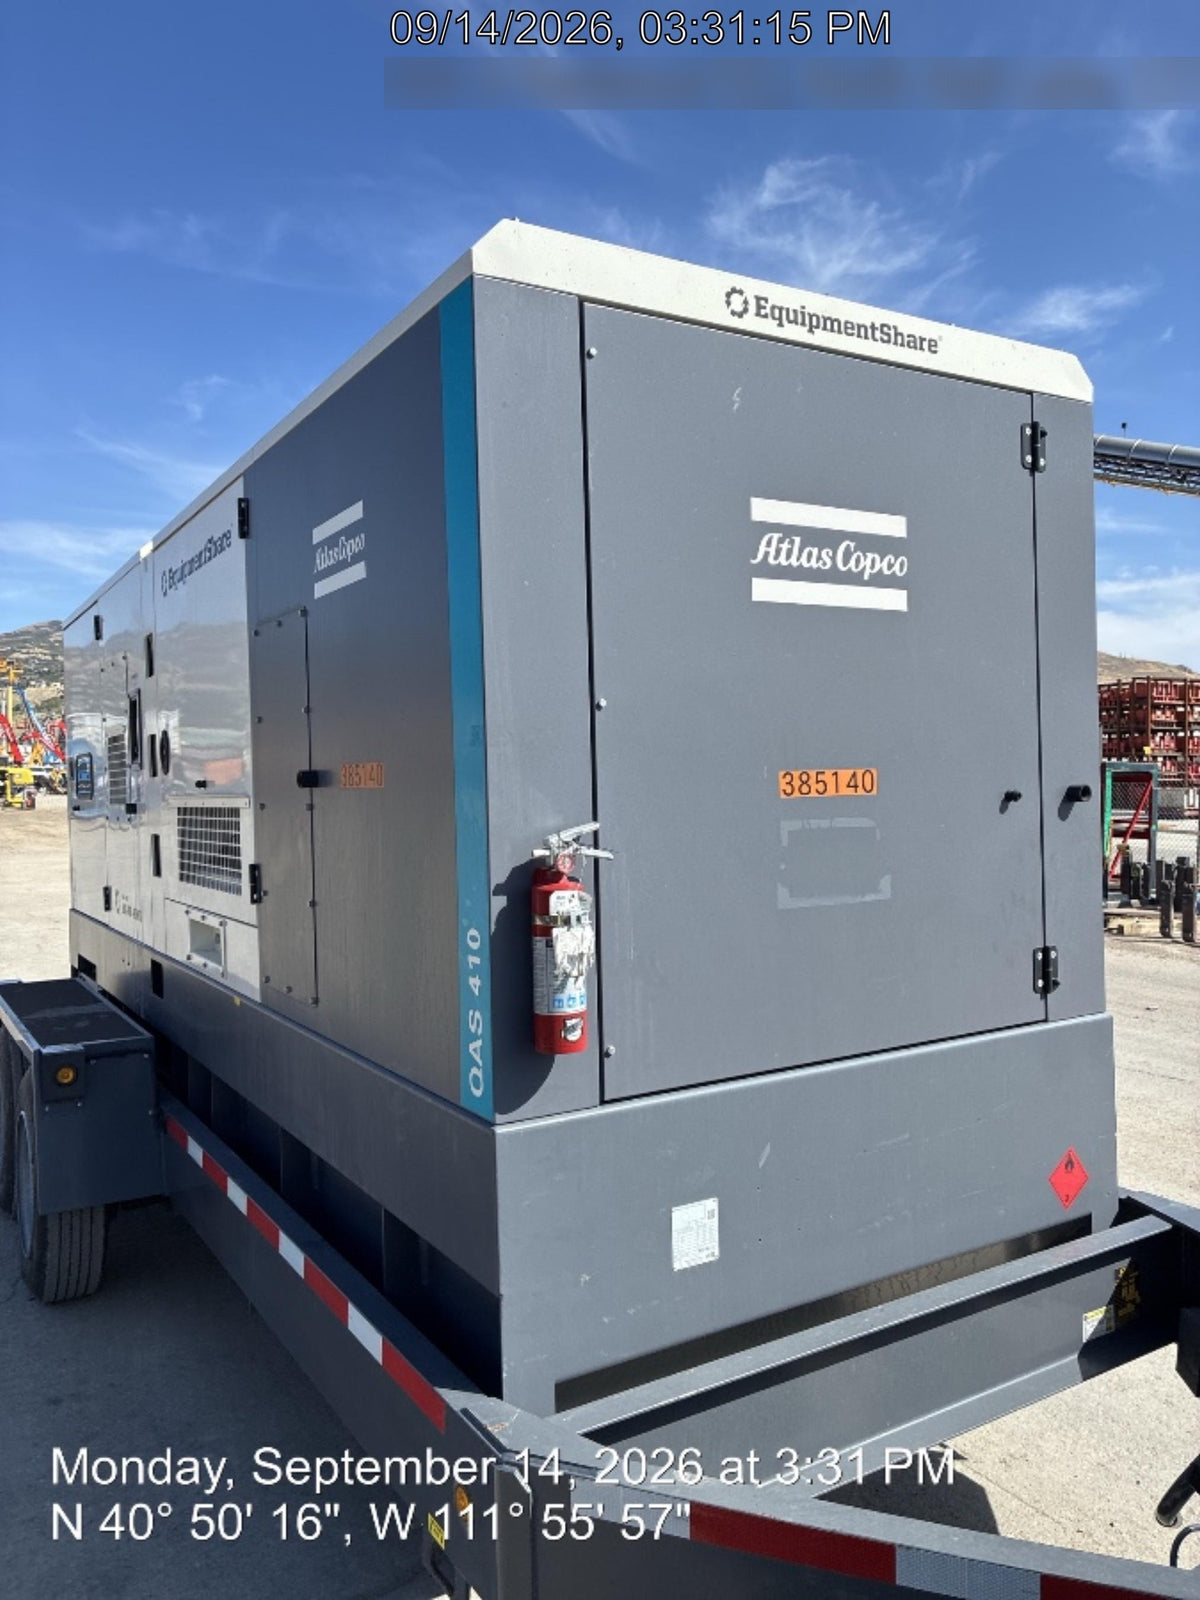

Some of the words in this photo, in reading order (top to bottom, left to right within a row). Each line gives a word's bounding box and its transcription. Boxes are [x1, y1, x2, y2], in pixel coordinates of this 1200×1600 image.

[754, 294, 939, 354] EquipmentShare
[750, 532, 833, 570] Atlas
[835, 540, 908, 580] Copco
[781, 769, 875, 797] 385140
[466, 927, 482, 996] 410
[467, 1009, 485, 1099] QAS
